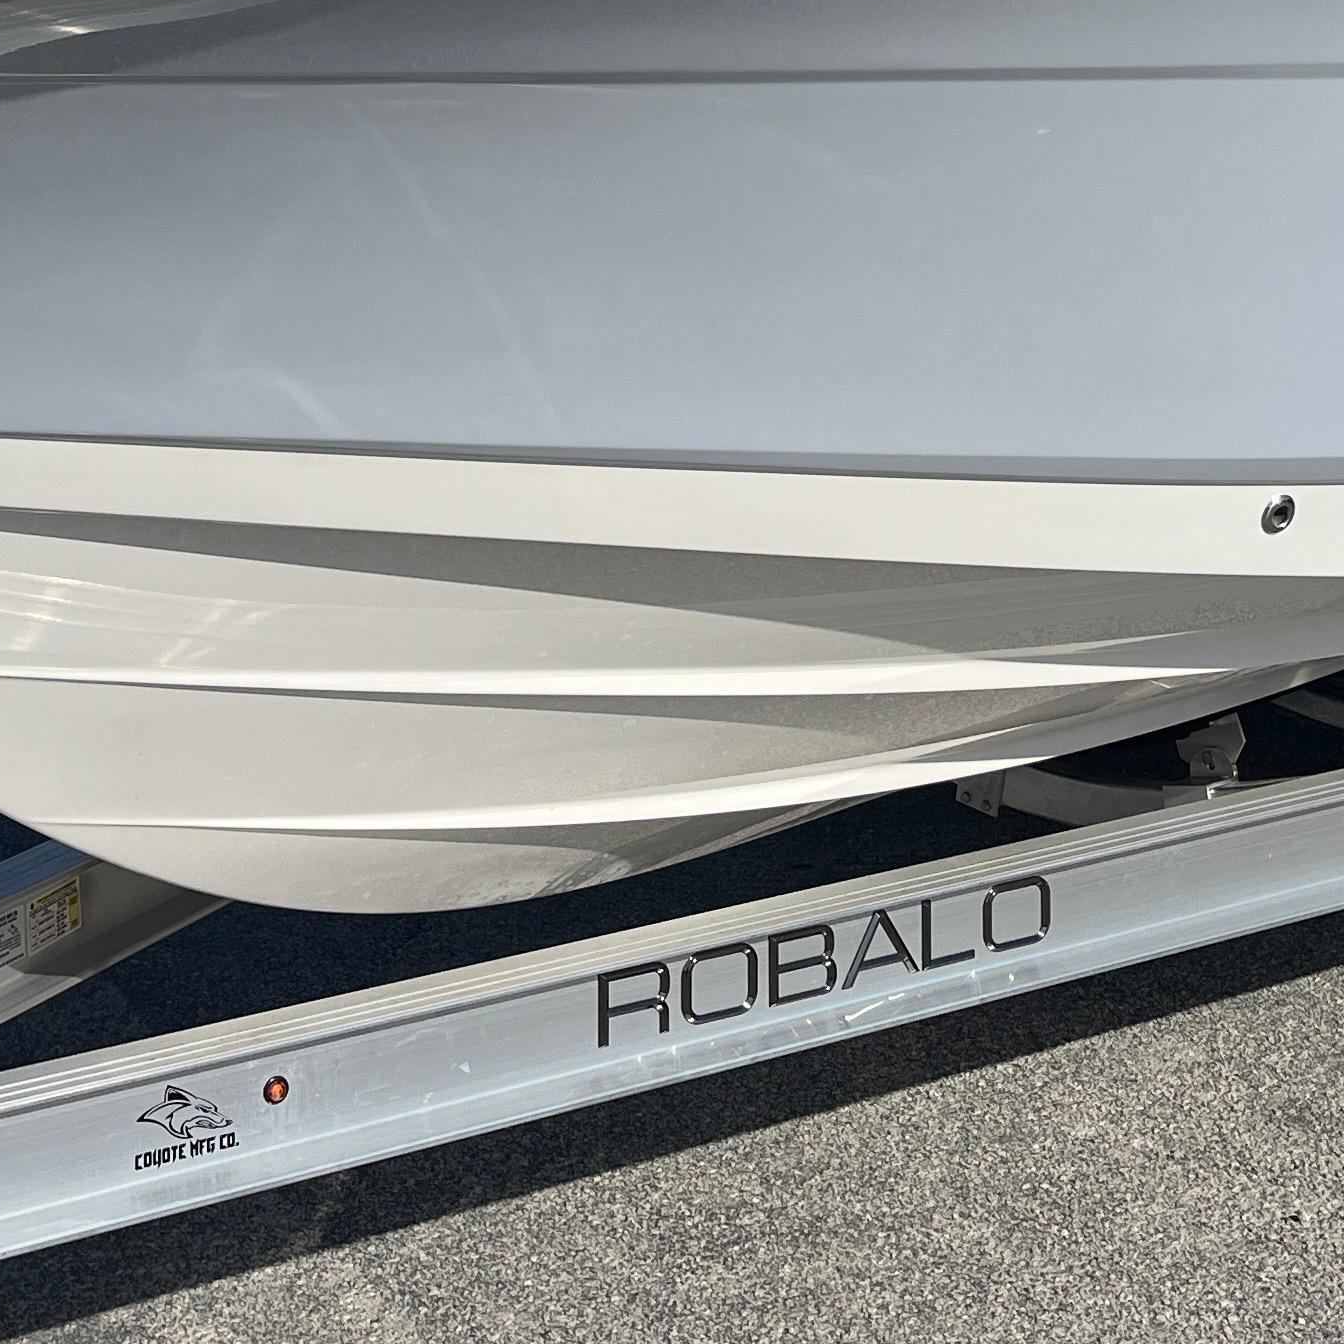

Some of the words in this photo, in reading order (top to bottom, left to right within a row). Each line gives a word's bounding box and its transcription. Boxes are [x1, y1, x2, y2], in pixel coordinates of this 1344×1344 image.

[597, 875, 1052, 1048] ROBALO
[134, 1142, 187, 1170] COYOTE
[189, 1135, 217, 1159] MFG
[219, 1131, 240, 1150] CO.
